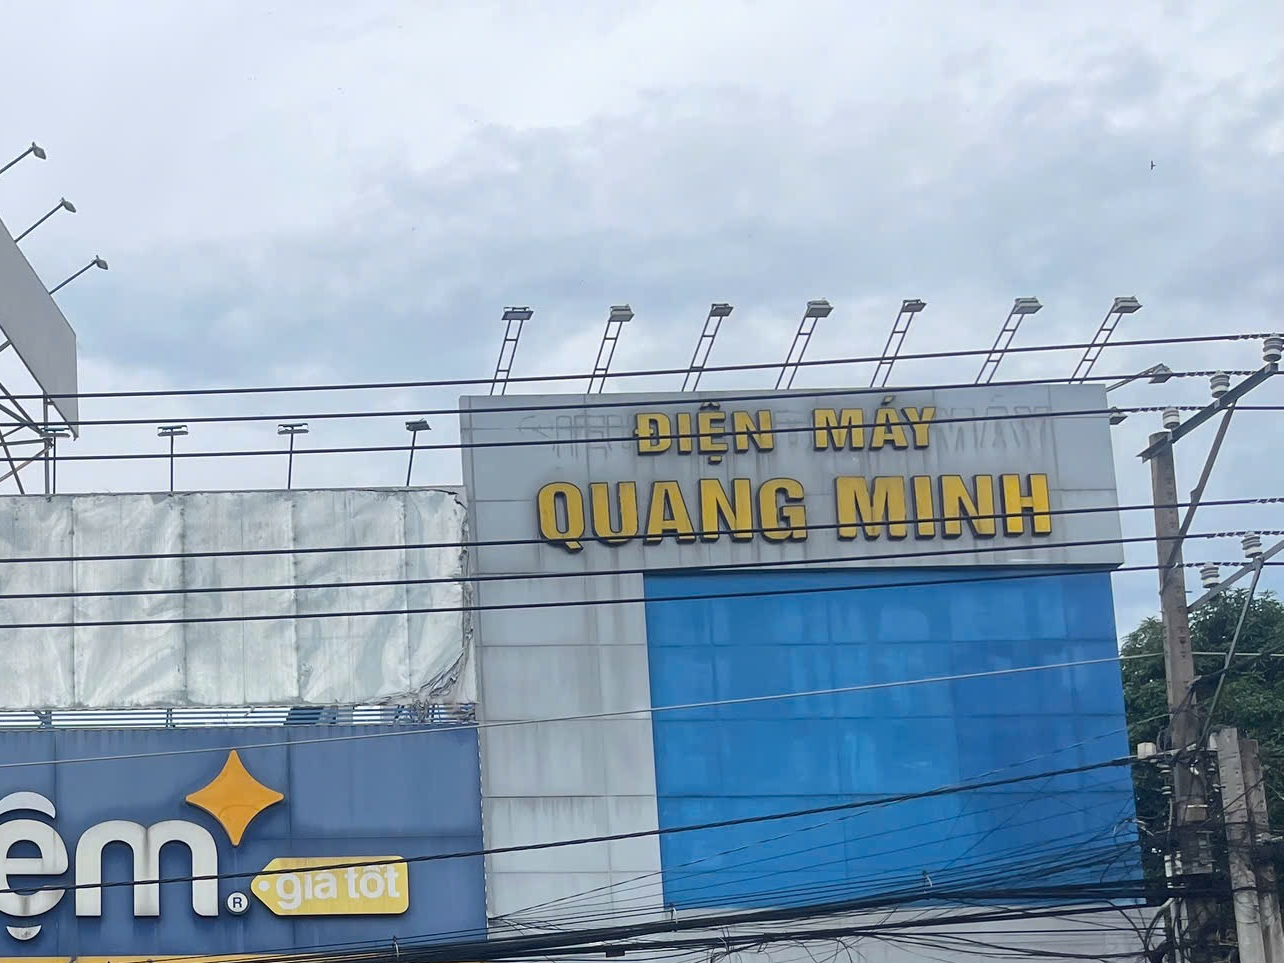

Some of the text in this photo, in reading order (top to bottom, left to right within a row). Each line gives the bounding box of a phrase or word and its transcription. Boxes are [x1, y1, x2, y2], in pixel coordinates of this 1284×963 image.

[632, 401, 774, 465] ĐIỆN
[812, 395, 936, 451] MÁY
[536, 472, 1052, 553] QUANG MINH
